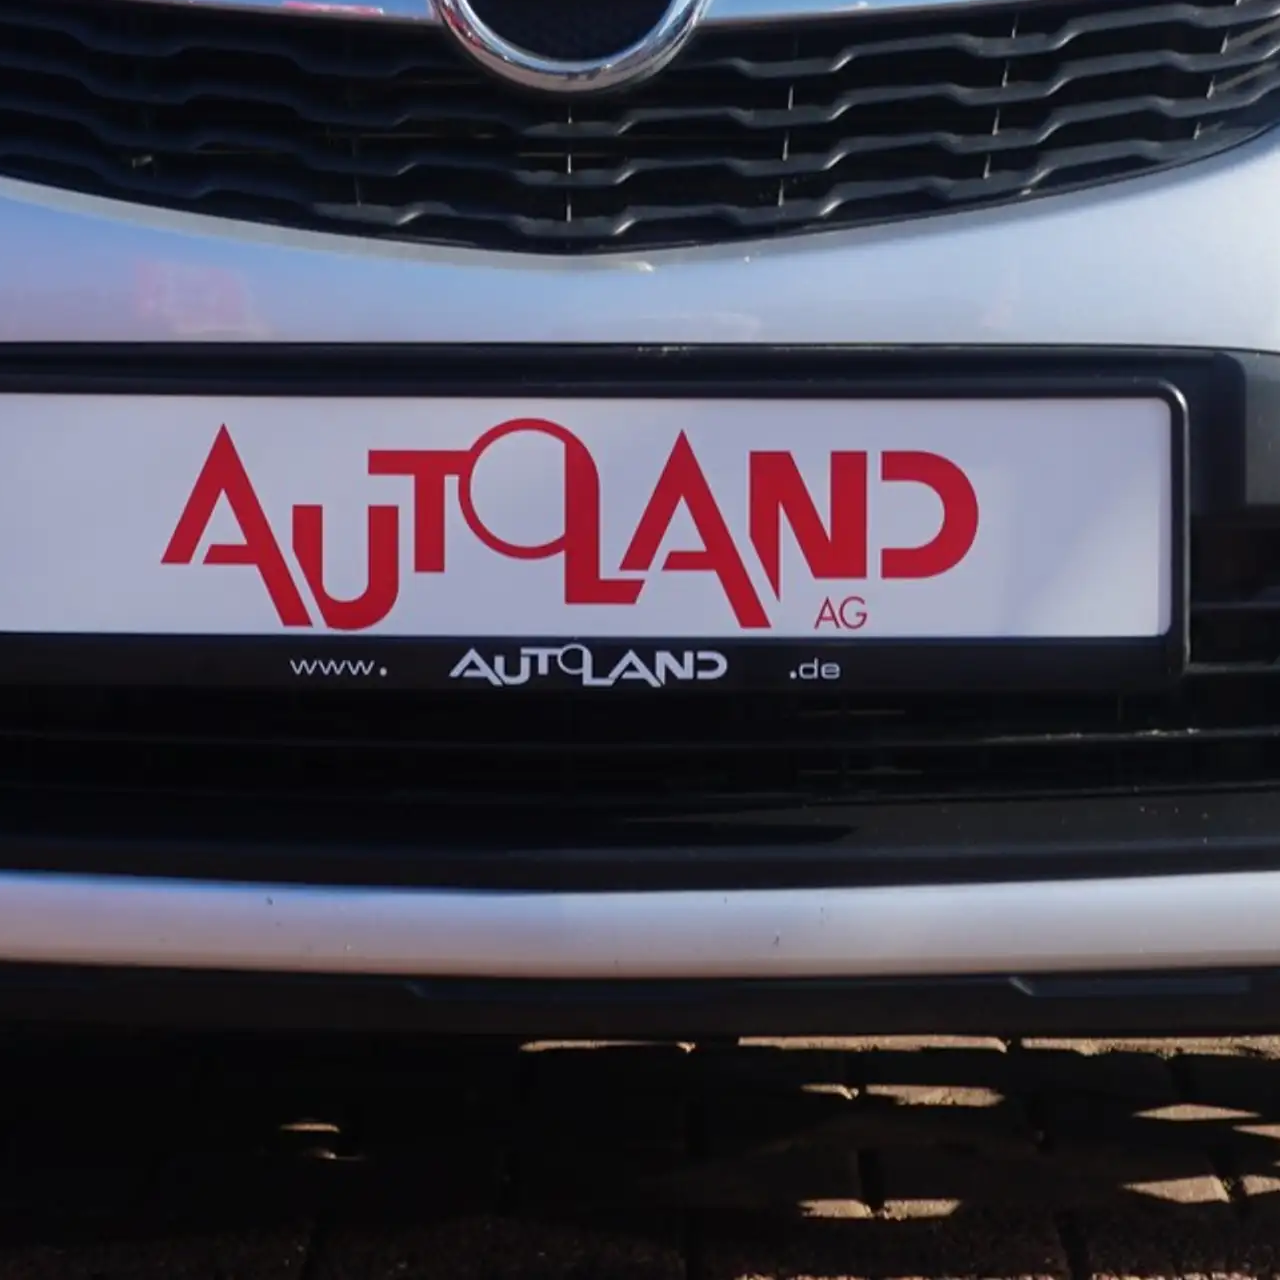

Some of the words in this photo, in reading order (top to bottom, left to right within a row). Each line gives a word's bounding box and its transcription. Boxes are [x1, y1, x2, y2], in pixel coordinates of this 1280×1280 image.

[814, 595, 869, 630] AG
[290, 659, 388, 676] www.
[789, 658, 840, 679] .de
